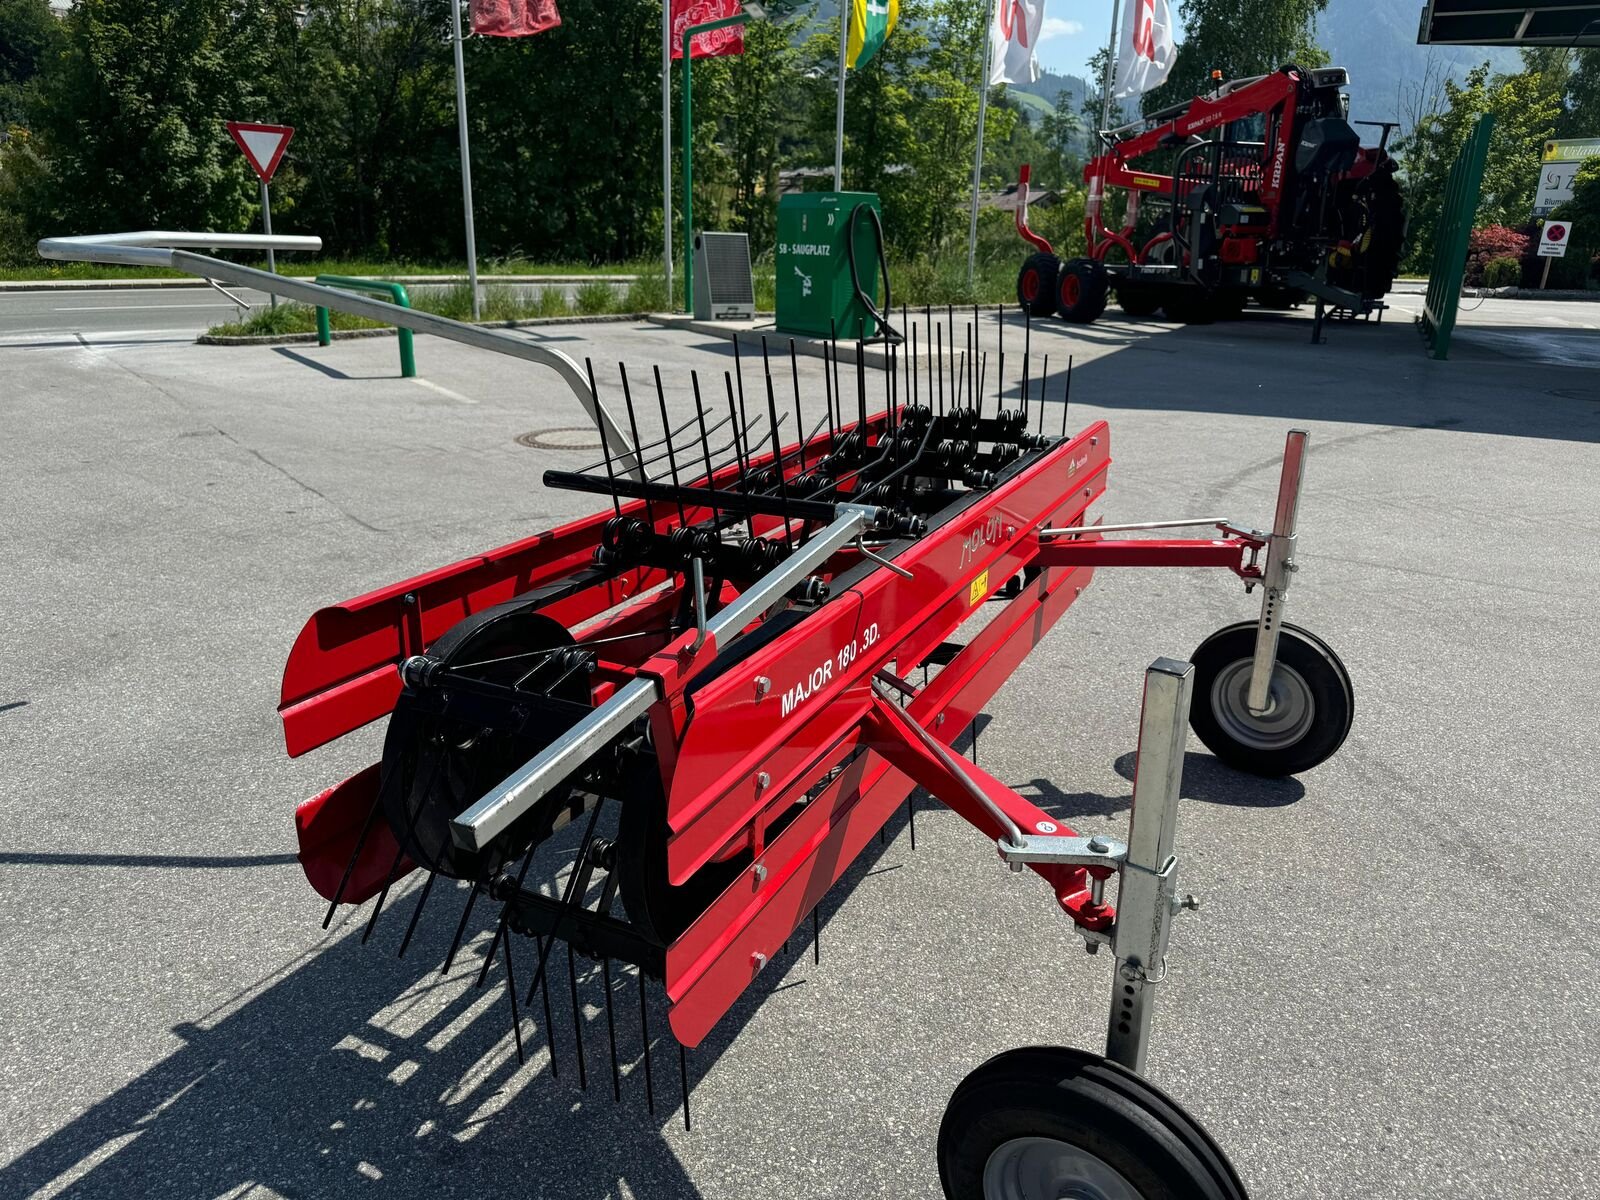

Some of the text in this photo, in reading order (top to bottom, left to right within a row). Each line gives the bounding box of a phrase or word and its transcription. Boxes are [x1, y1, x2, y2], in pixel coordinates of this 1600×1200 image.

[1271, 142, 1286, 189] KRPAN
[779, 243, 788, 254] SB
[792, 243, 831, 256] SAUGPLATZ
[782, 659, 833, 718] MAJOR
[837, 639, 857, 671] 180
